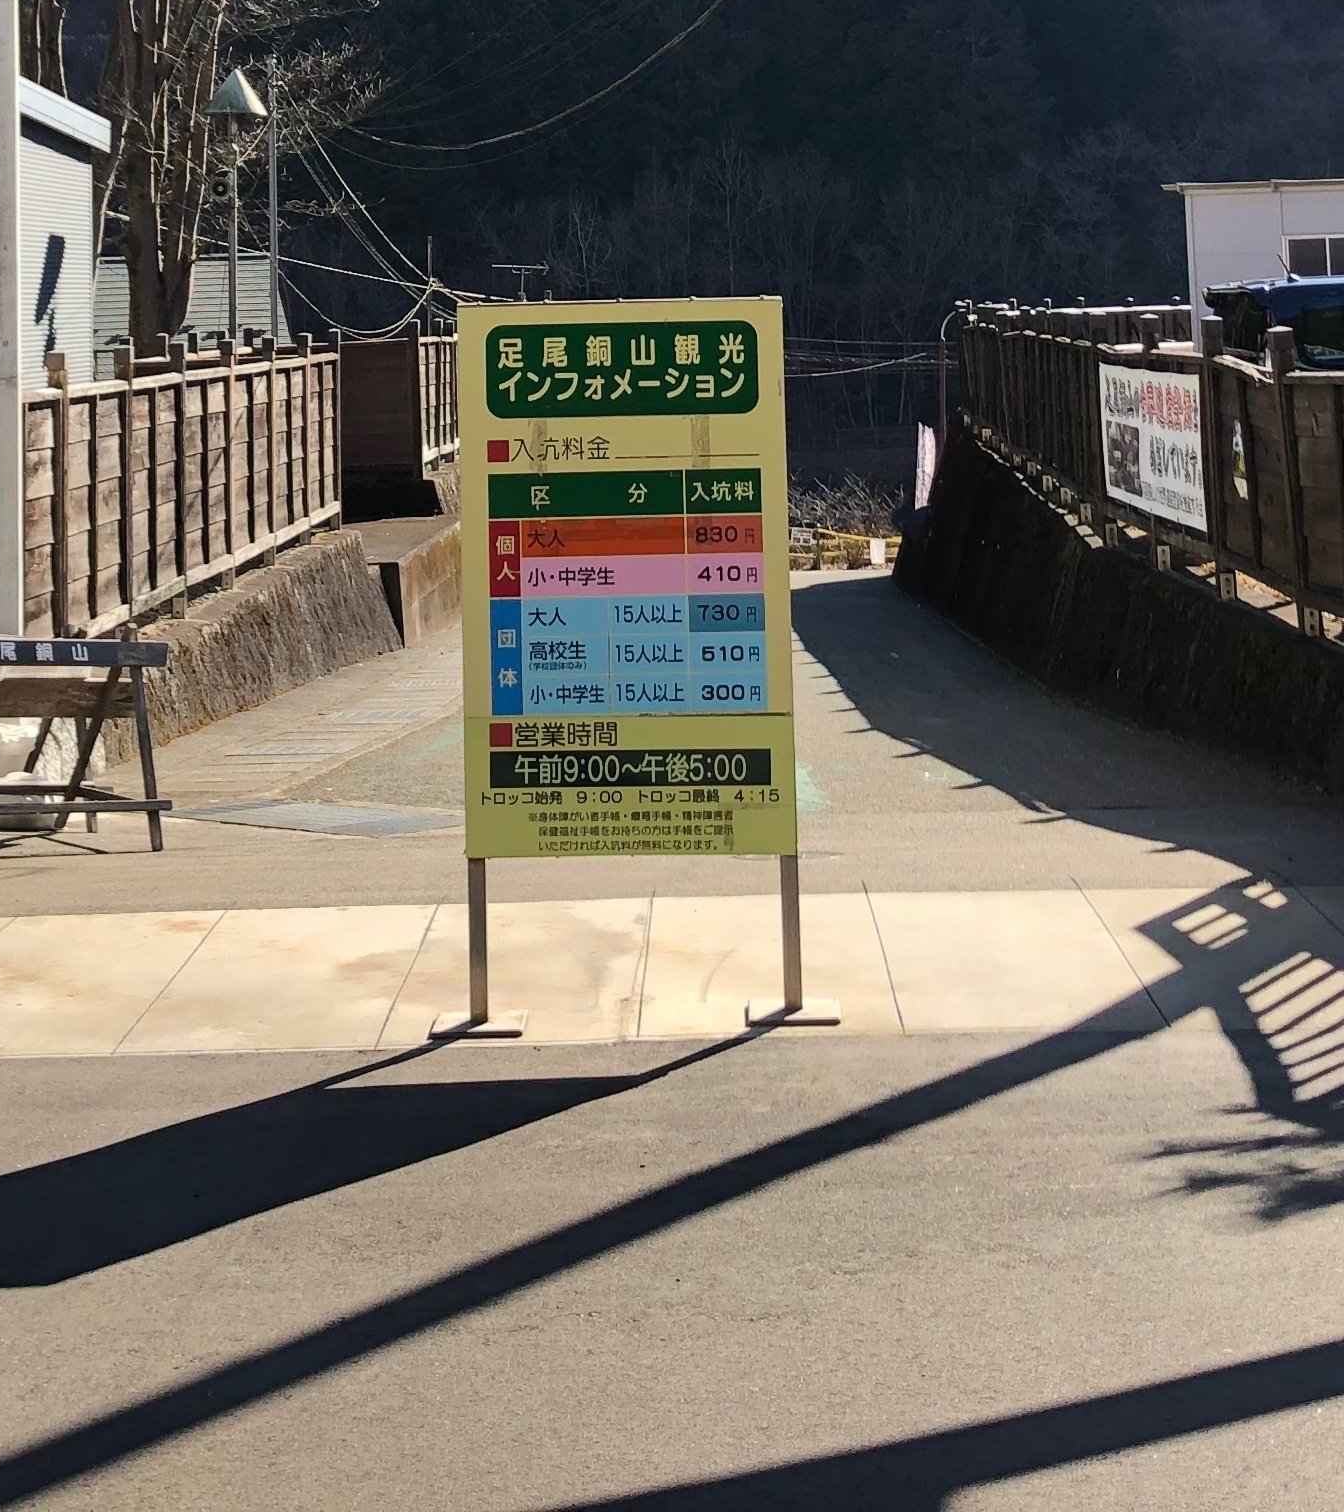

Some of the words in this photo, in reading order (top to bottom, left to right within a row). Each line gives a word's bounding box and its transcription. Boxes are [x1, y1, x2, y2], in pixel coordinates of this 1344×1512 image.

[498, 333, 745, 369] 足尾銅山観光
[498, 369, 745, 402] インフォメーション
[511, 435, 611, 462] 入坑料金
[690, 480, 755, 503] 入坑料
[526, 529, 566, 549] 大人
[495, 535, 518, 581] 個人
[527, 566, 616, 588] 小・中学生
[528, 606, 567, 628] 大人
[613, 604, 683, 625] 15人以上
[529, 640, 588, 660] 高校生
[614, 644, 684, 664] 15人以上
[530, 683, 605, 705] 小・中学生
[616, 683, 685, 703] 15人以上
[514, 721, 618, 748] 営業時間
[480, 788, 563, 806] トロッコ始発
[638, 788, 721, 804] トロッコ最終
